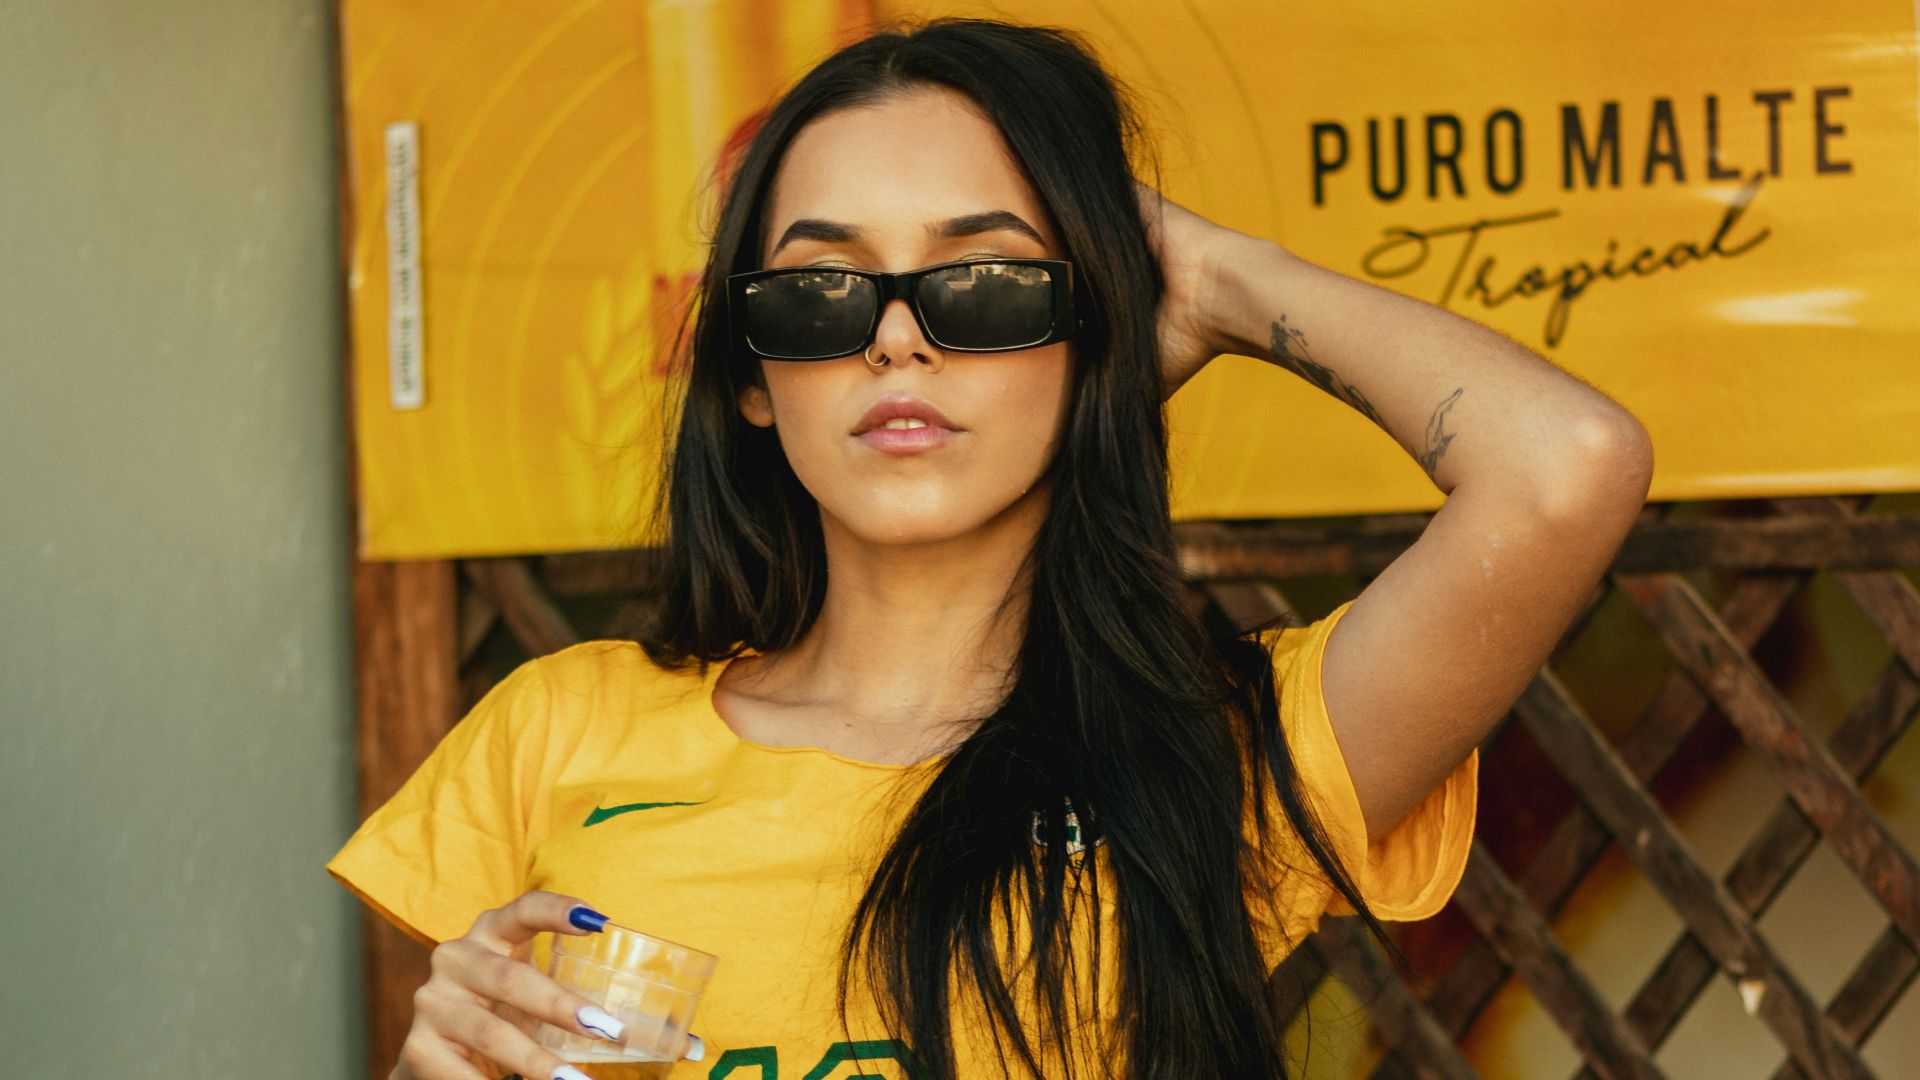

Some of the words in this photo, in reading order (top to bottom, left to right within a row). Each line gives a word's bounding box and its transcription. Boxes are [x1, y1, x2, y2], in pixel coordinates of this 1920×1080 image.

[1310, 108, 1524, 206] PURO
[1560, 85, 1854, 190] MALTE
[1361, 170, 1771, 348] Tropical
